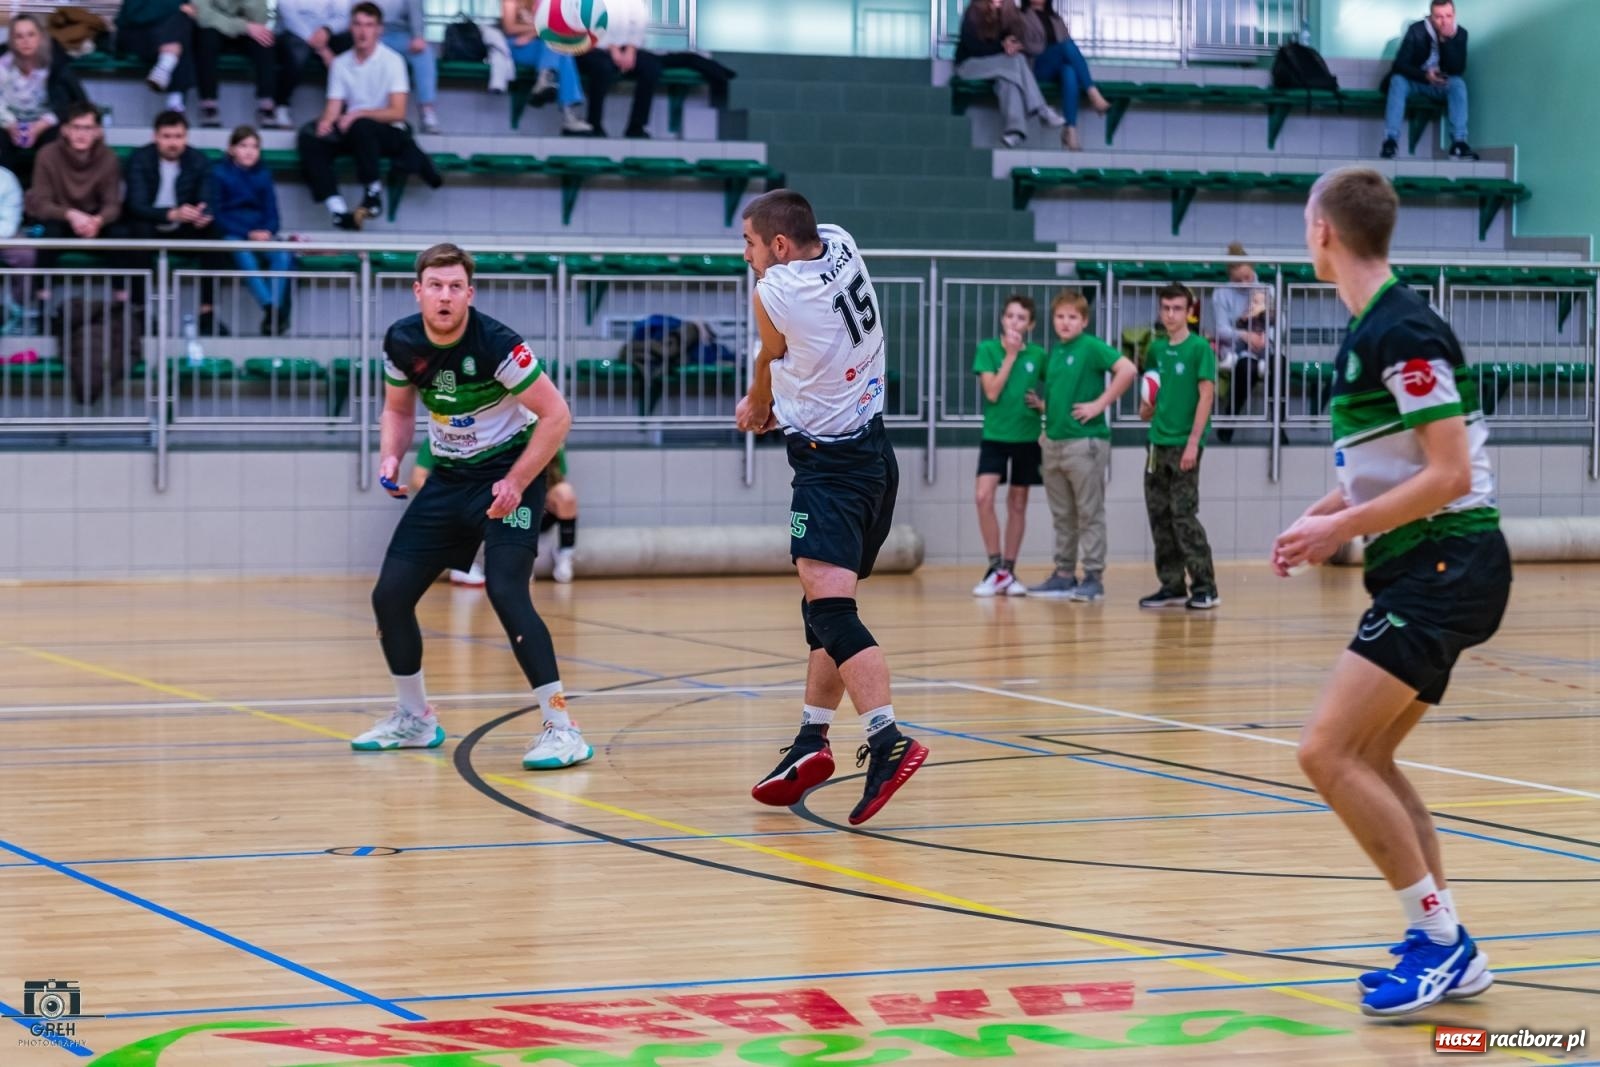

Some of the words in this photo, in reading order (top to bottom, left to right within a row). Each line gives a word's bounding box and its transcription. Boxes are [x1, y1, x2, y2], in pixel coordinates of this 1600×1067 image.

[832, 271, 877, 348] 15
[432, 370, 457, 393] 49
[503, 507, 531, 529] 49
[790, 511, 809, 539] 5
